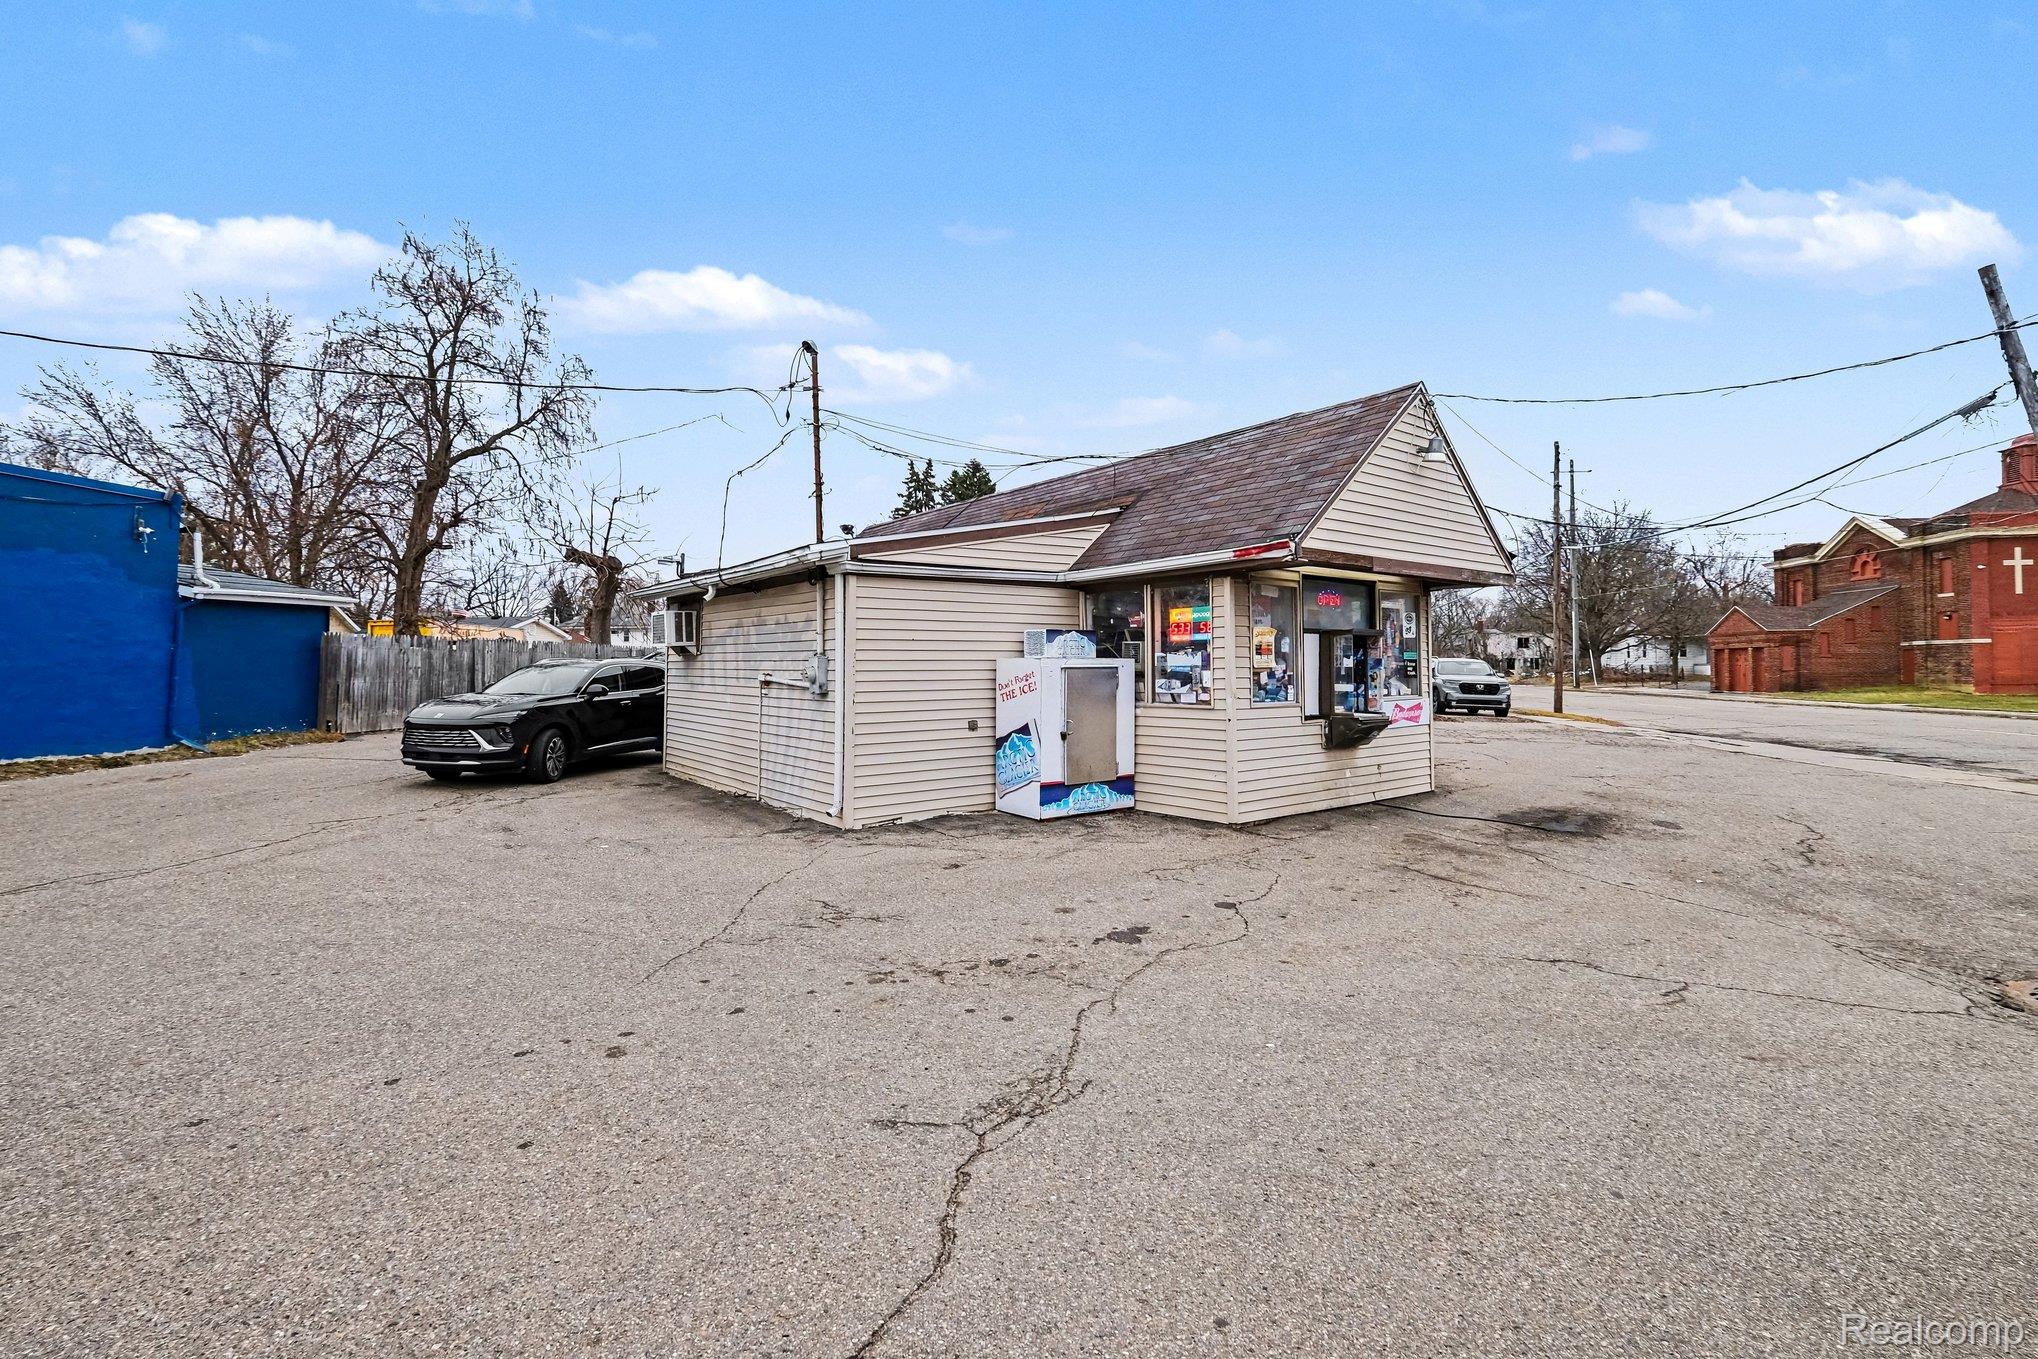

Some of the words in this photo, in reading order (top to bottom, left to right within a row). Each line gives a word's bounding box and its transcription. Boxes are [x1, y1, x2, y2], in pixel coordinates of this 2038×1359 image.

[1317, 595, 1341, 606] OPEN
[1014, 671, 1035, 684] Forget
[1000, 689, 1017, 702] THE
[1019, 681, 1037, 696] ICE!
